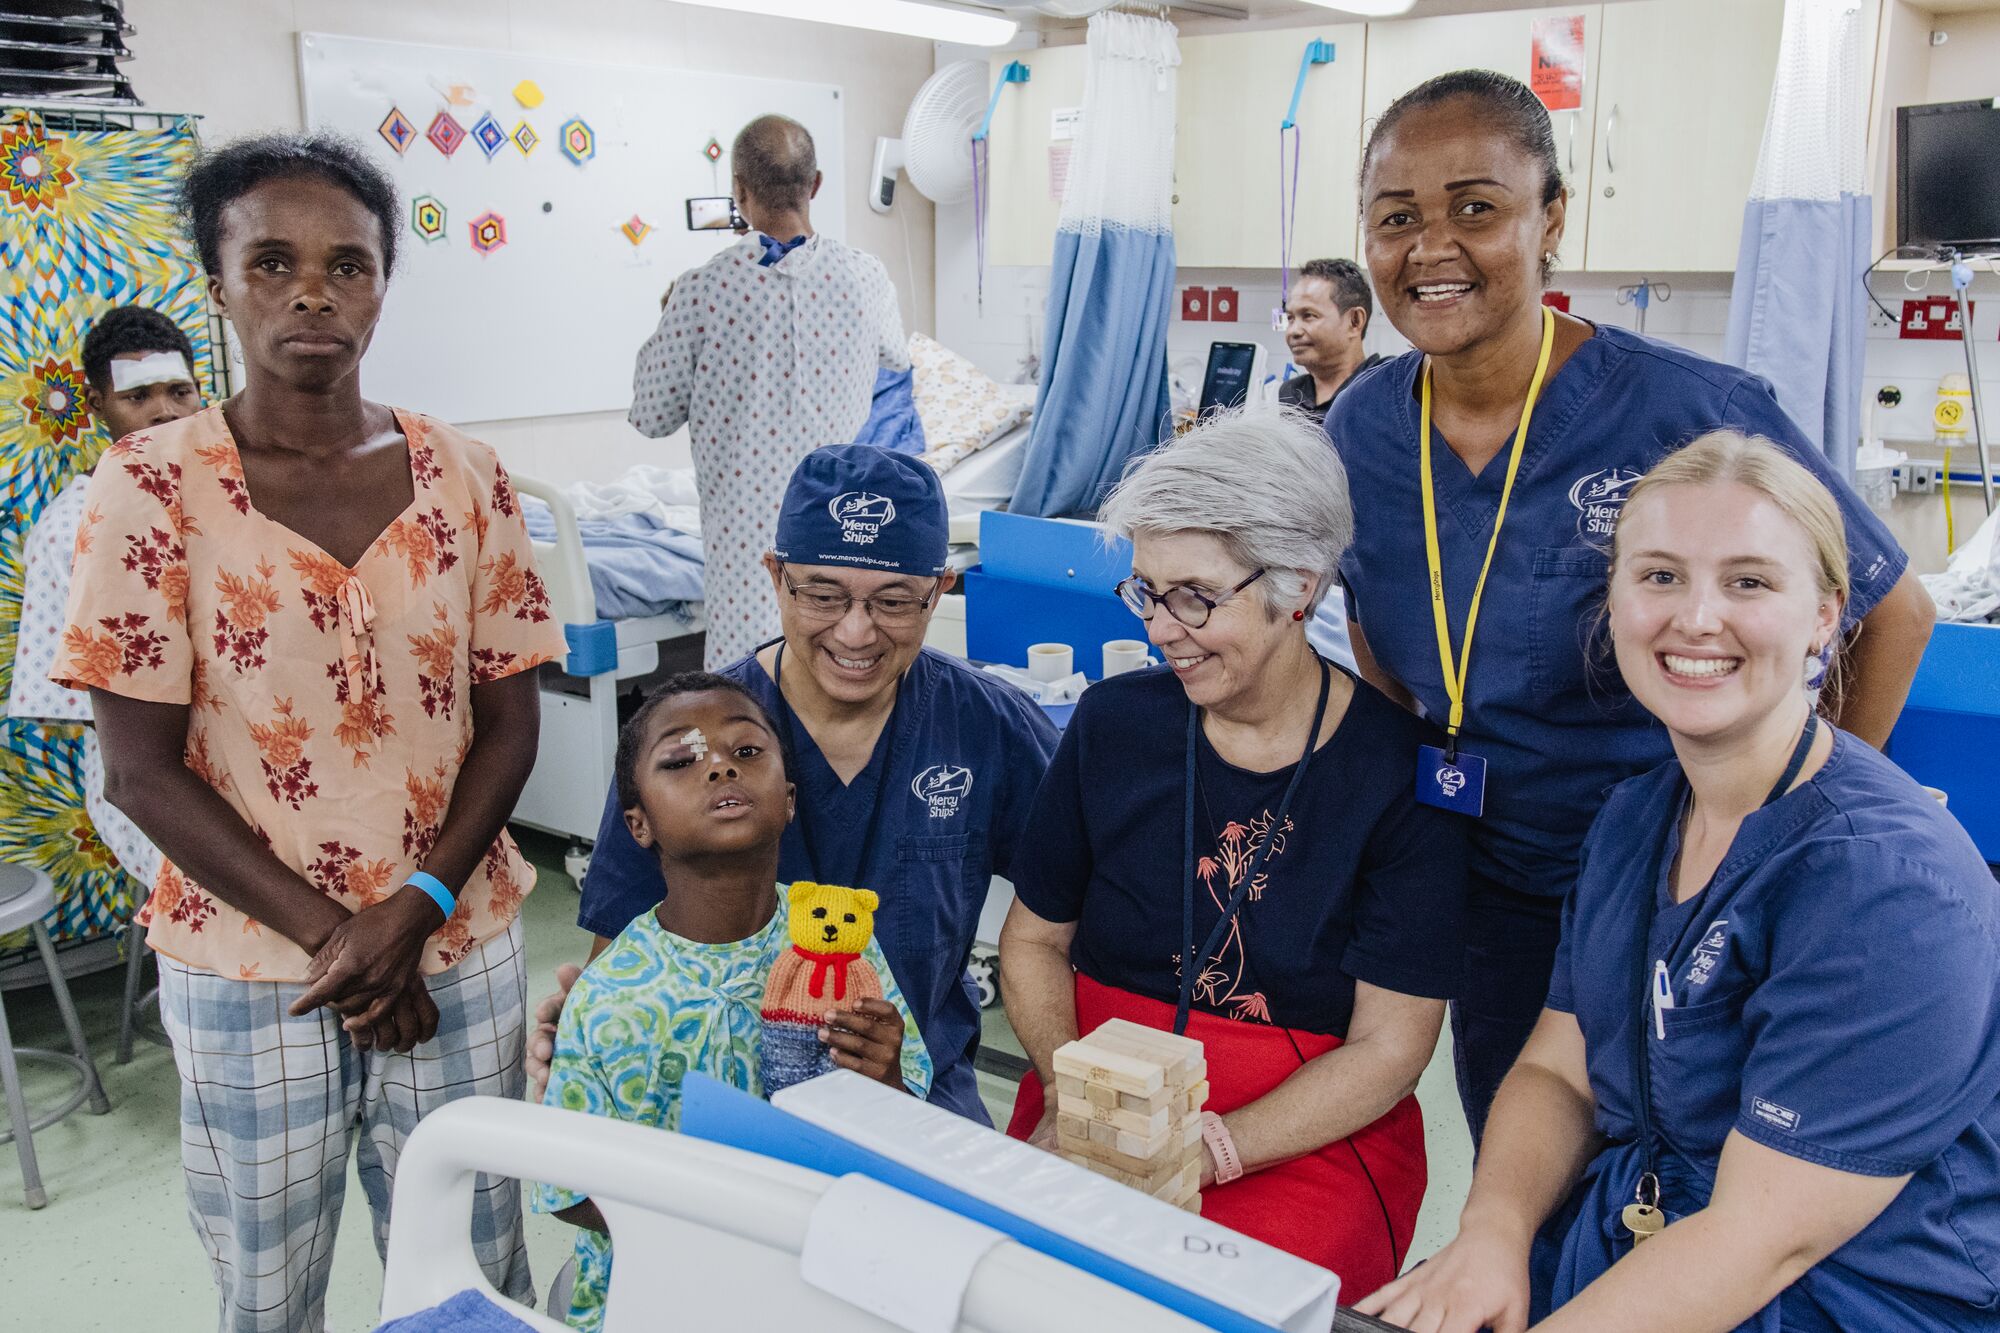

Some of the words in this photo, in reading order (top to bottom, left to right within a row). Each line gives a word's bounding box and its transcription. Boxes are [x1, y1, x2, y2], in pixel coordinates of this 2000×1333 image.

[1586, 505, 1621, 518] Merc
[841, 519, 879, 533] Mercy
[1586, 519, 1617, 536] Ship
[818, 553, 900, 568] www.mercyships.org.uk
[928, 795, 959, 807] Mercy
[1184, 1235, 1239, 1259] D6
